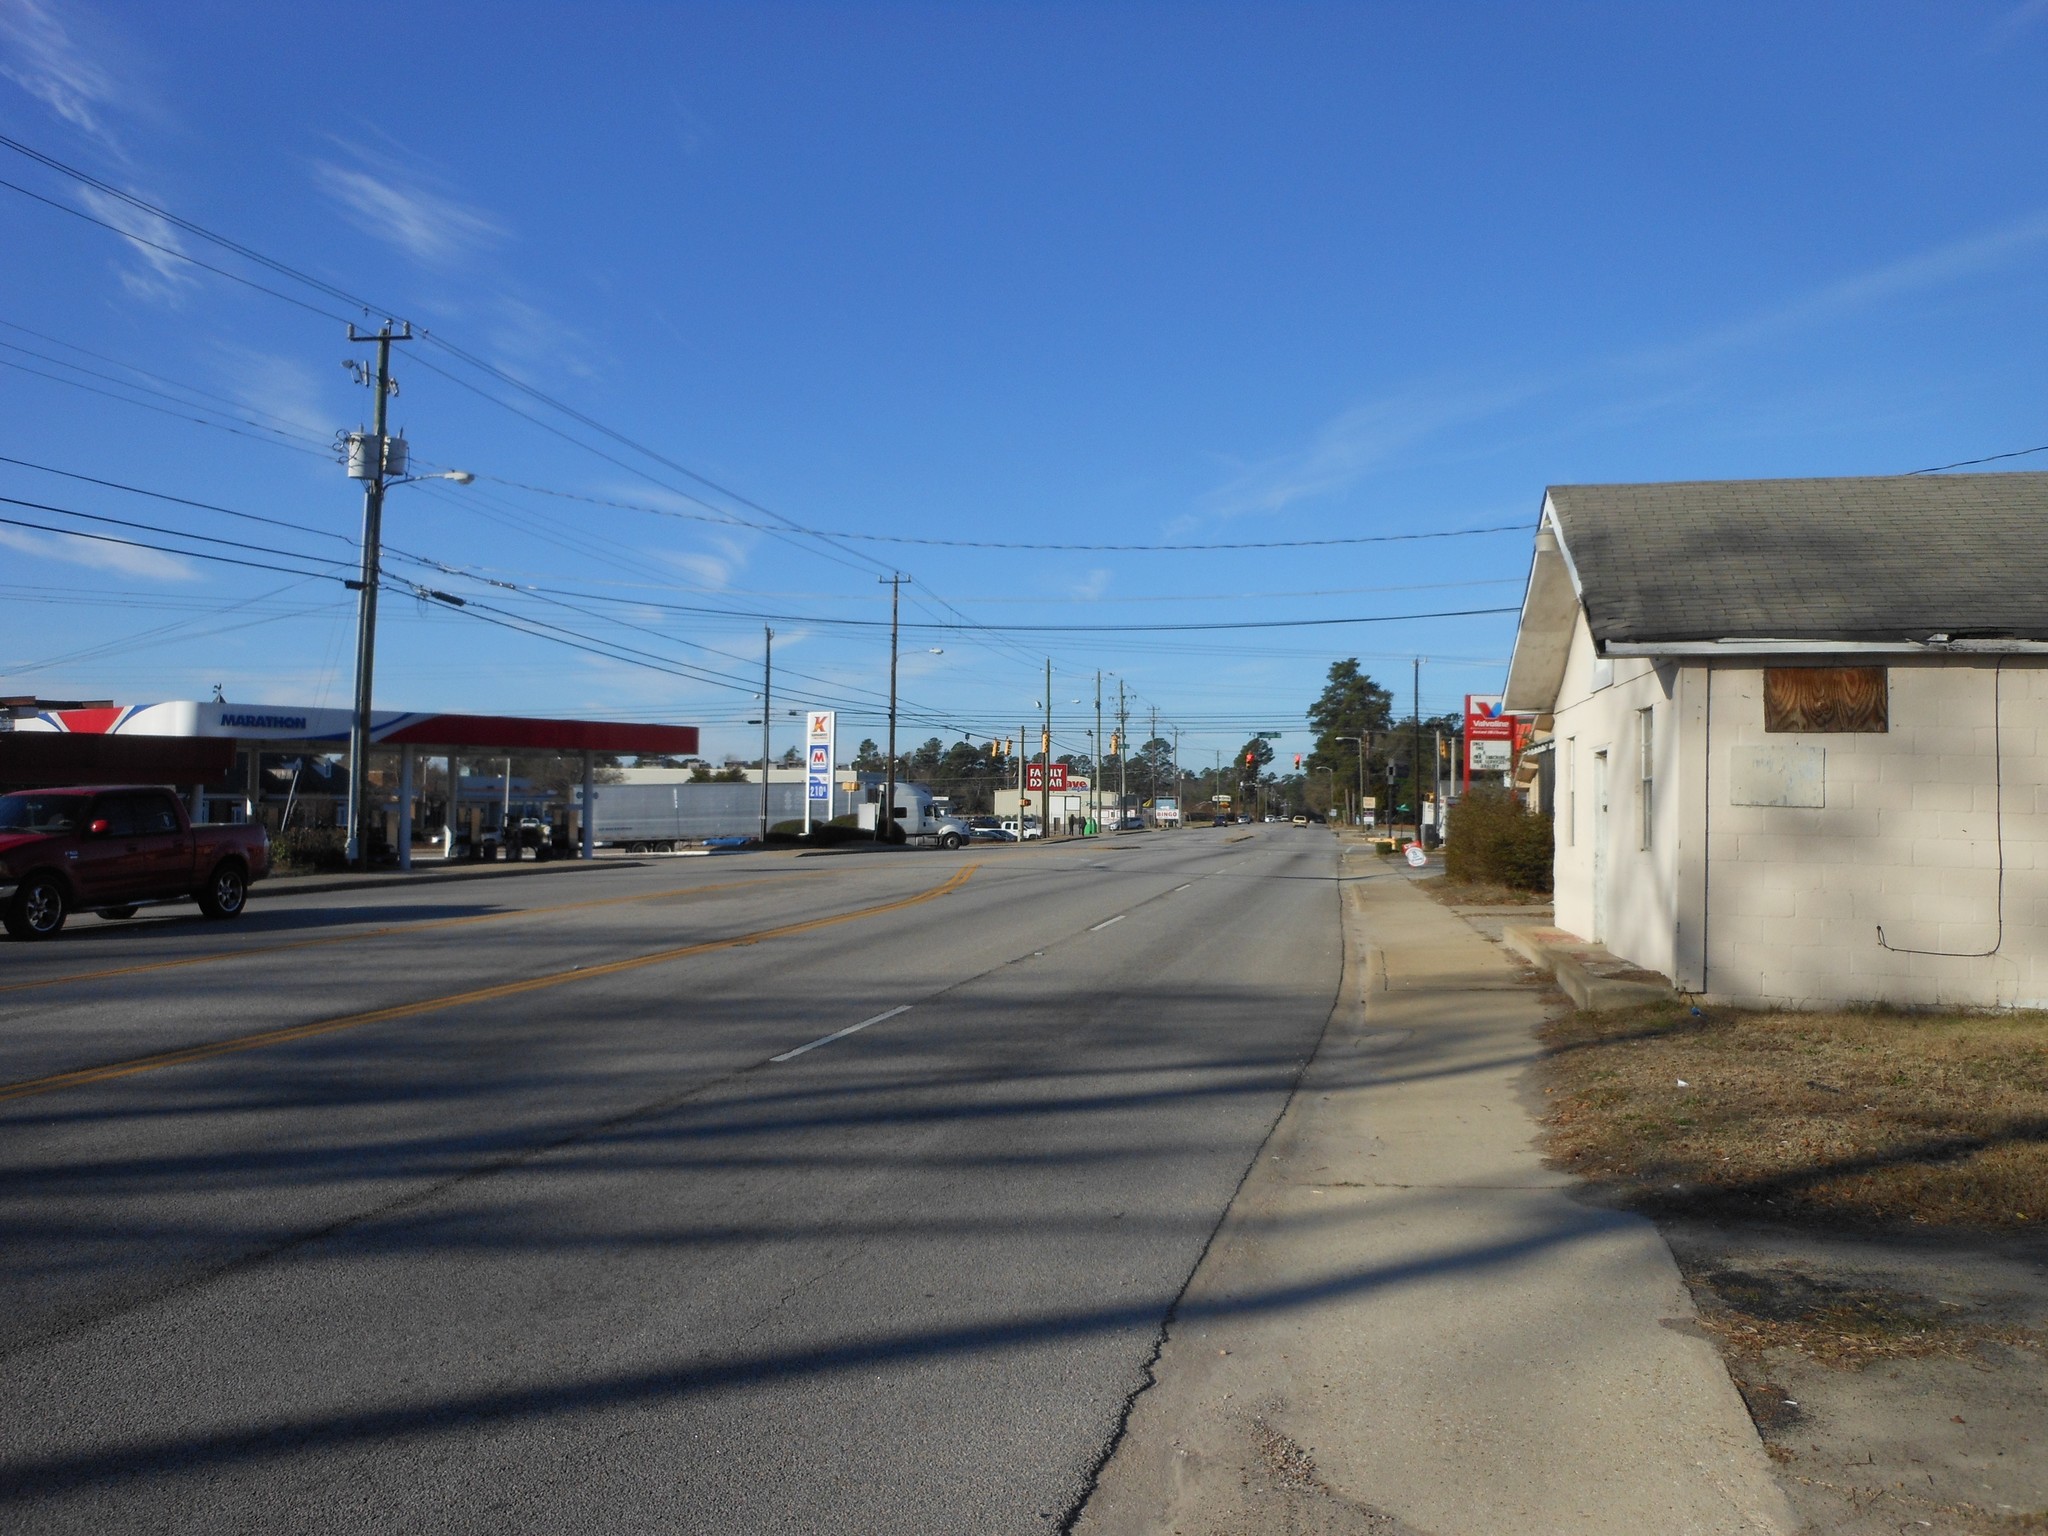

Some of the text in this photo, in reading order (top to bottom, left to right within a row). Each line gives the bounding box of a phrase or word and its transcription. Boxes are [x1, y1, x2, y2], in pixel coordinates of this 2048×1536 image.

[220, 714, 307, 729] MARATHON
[812, 716, 828, 732] K
[813, 752, 824, 762] M
[1030, 768, 1063, 777] FAILY
[1030, 779, 1063, 788] DOAR
[1067, 780, 1087, 788] ave
